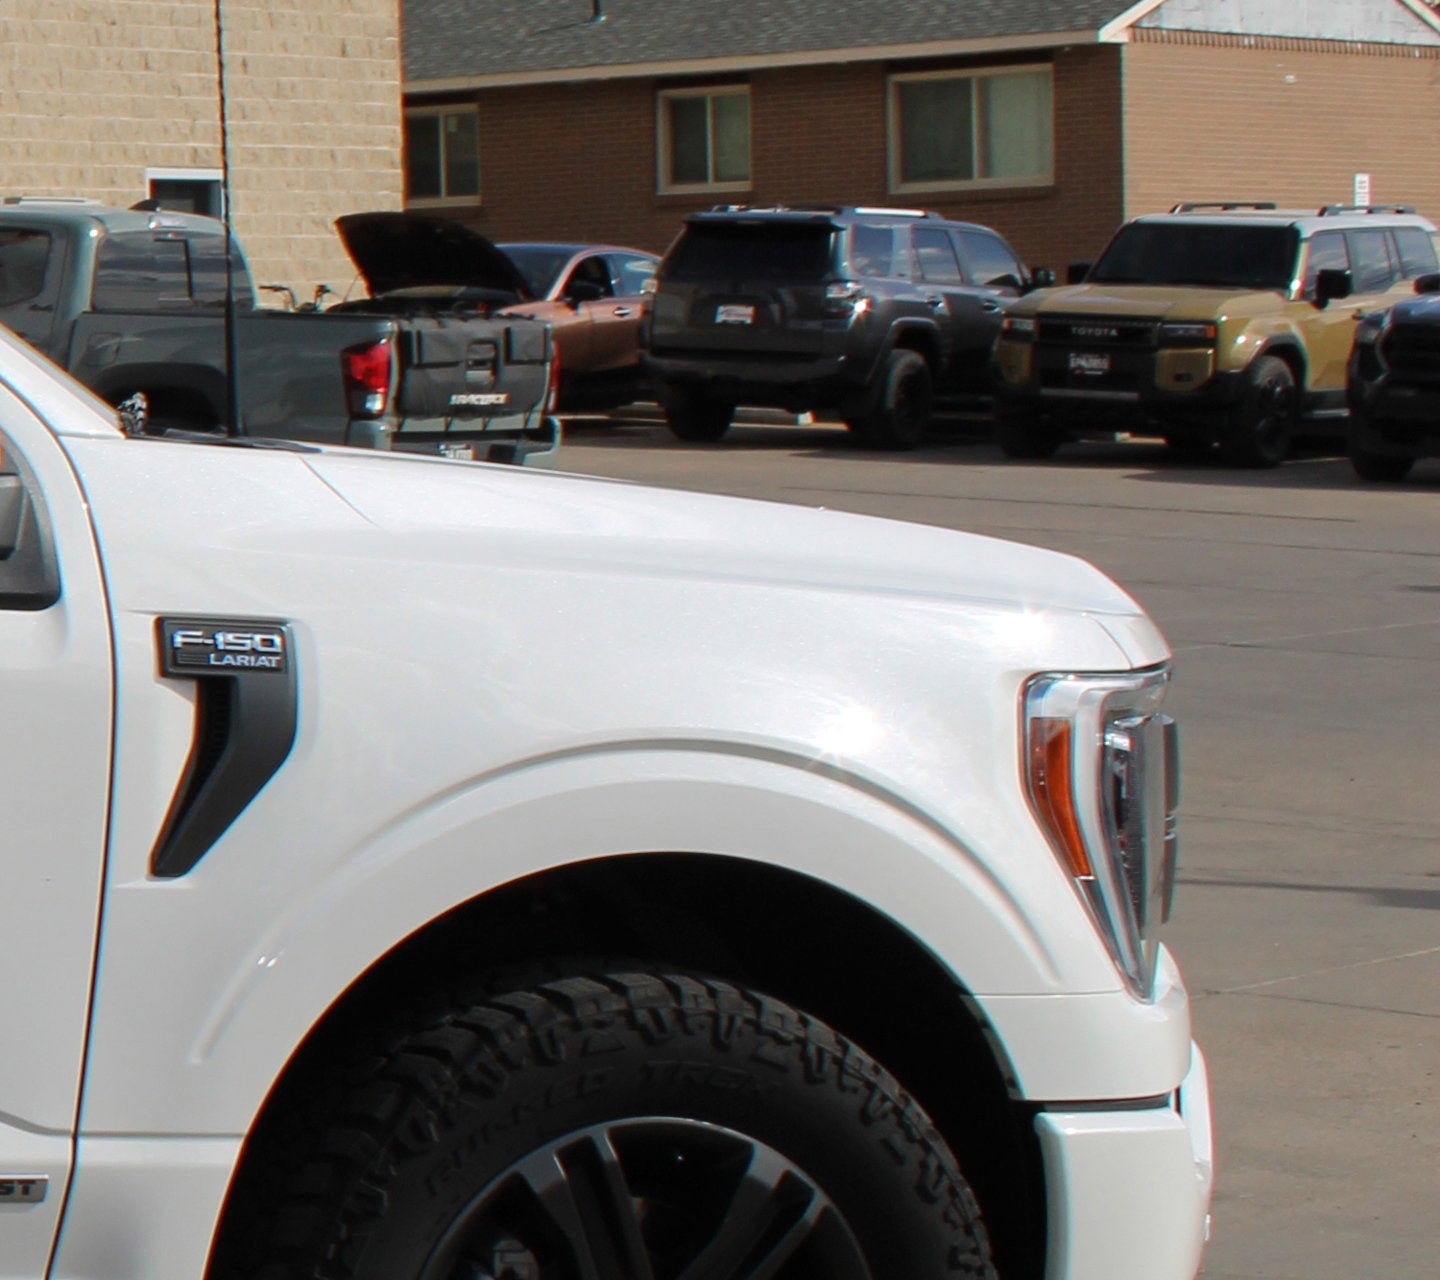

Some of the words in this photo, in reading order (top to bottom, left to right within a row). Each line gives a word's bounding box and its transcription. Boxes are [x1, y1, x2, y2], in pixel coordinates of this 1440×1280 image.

[1071, 327, 1120, 337] TOYOTA
[172, 629, 283, 652] F-150
[209, 653, 282, 668] LARIAT
